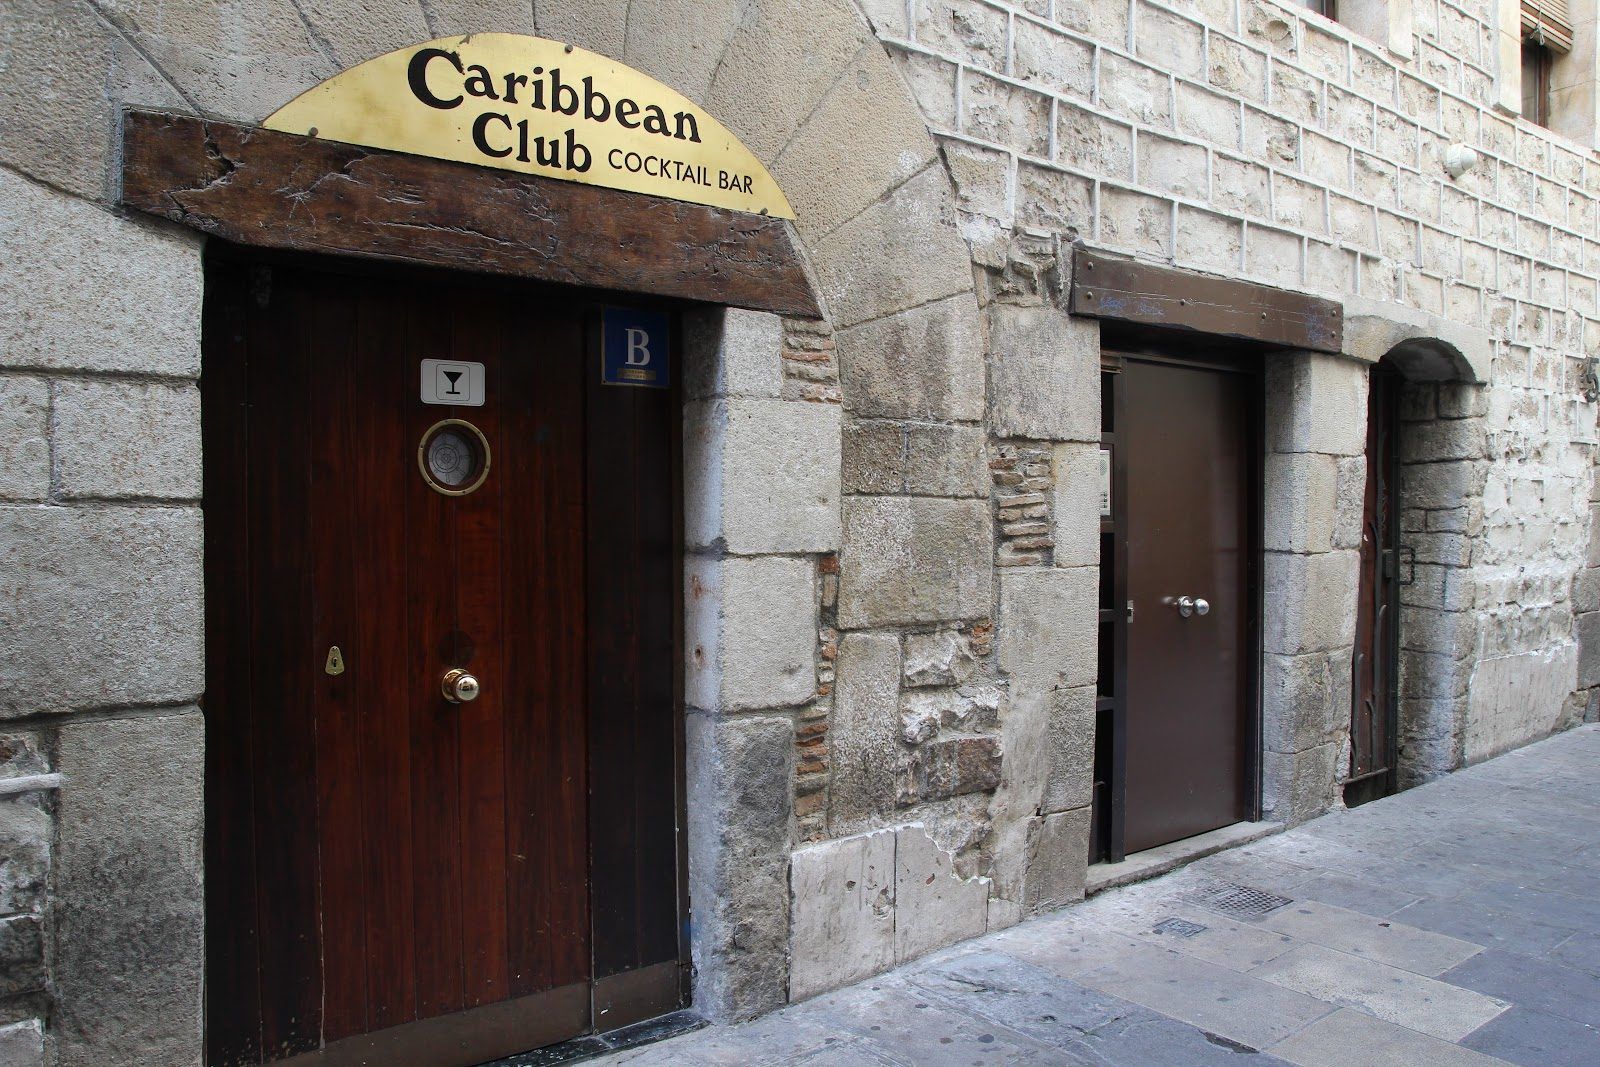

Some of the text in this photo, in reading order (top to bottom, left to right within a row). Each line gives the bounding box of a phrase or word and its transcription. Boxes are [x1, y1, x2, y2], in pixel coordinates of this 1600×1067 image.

[408, 48, 702, 144] Caribbean
[472, 112, 754, 196] Club COCKTAIL BAR
[625, 328, 651, 366] B
